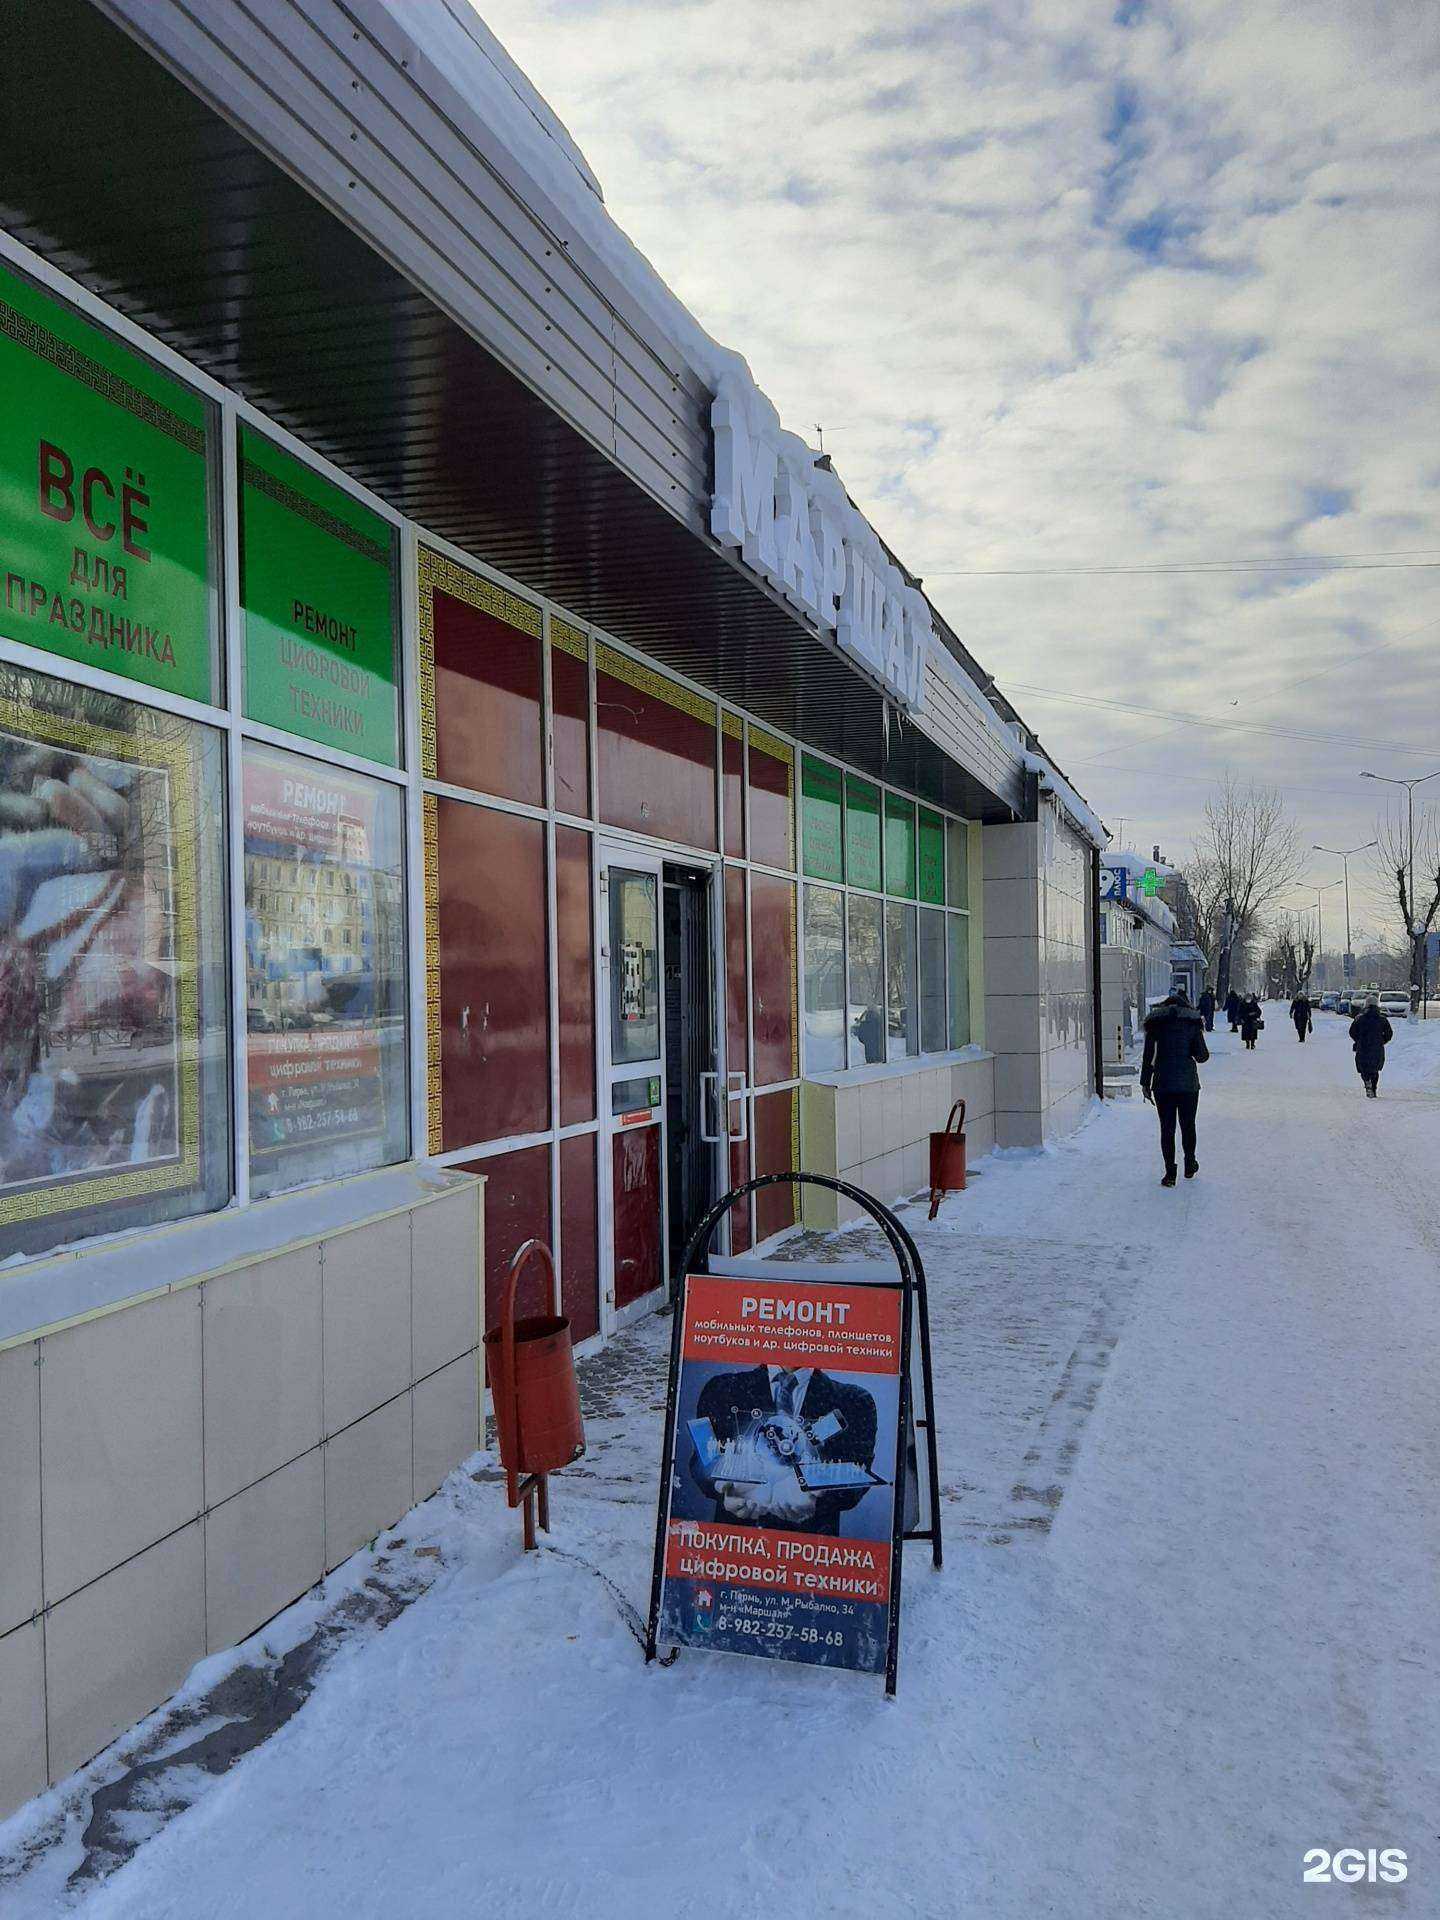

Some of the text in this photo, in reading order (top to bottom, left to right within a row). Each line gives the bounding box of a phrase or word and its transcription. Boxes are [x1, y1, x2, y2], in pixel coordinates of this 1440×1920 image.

[39, 438, 151, 563] ВСЁ
[70, 546, 128, 601] ДЛЯ
[5, 572, 177, 669] ПРАЗДНИКА
[291, 599, 357, 652] РЕМОНТ
[288, 682, 365, 737] ТЕХНИКИ
[741, 1296, 850, 1325] РЕМОНТ
[694, 1319, 895, 1344] мобильных телефонов, планшетов,
[694, 1334, 893, 1358] ноутбуков и др. цифровой техники
[679, 1530, 875, 1570] ПОКУПКА, ПРОДАЖА
[680, 1556, 878, 1596] цифровой техники
[720, 1591, 728, 1600] г.
[730, 1589, 763, 1606] Пермь,
[765, 1595, 777, 1607] ул.
[794, 1599, 840, 1616] Рыбалко,
[841, 1604, 855, 1615] 34
[718, 1615, 844, 1647] 8-982-257-58-68
